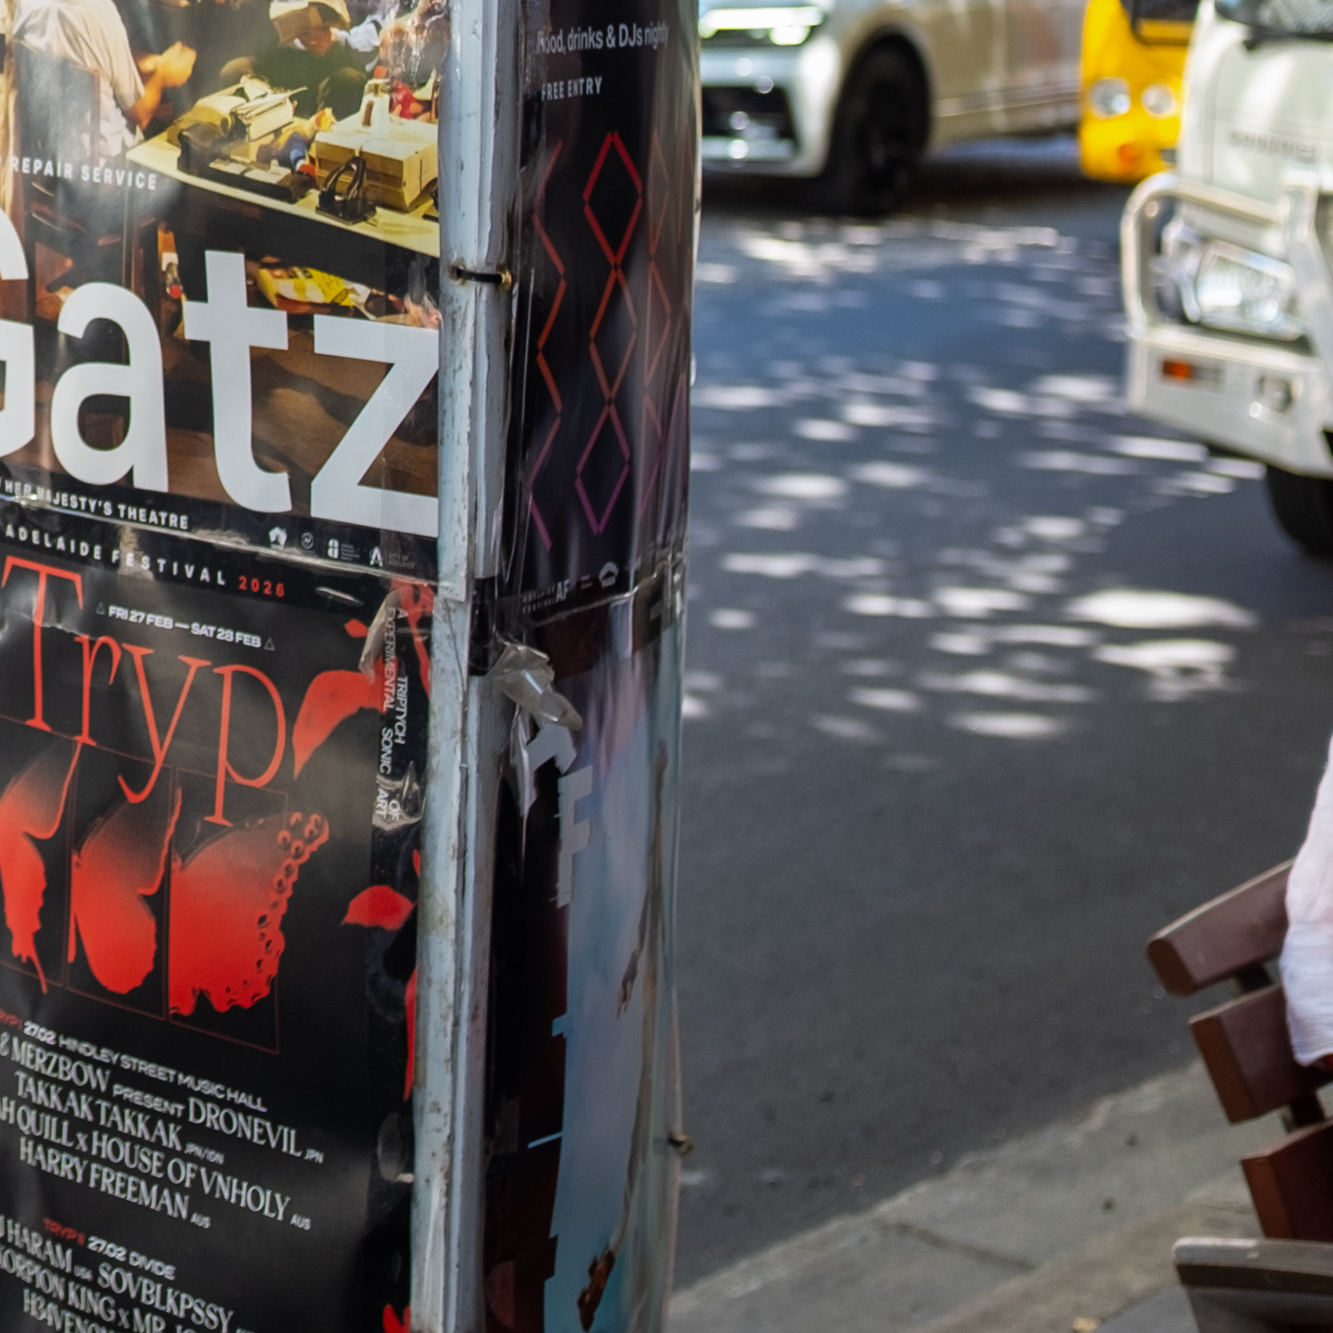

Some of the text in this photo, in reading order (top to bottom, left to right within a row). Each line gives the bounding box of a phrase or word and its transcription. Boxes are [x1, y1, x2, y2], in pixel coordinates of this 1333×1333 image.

[567, 26, 603, 51] drinks
[606, 24, 616, 49] &
[618, 23, 643, 48] DJs
[541, 76, 603, 101] FREE ENTRY
[10, 156, 73, 179] REPAIR
[81, 166, 157, 191] SERVICE
[4, 481, 32, 498] HER
[117, 504, 189, 530] THEATRE
[5, 524, 286, 598] ADELAIDE FESTIVAL 2026
[108, 605, 128, 620] FRI
[128, 610, 146, 624] 27
[146, 614, 174, 629] FEB
[191, 622, 217, 638] SAT
[217, 628, 234, 642] 28
[235, 632, 262, 648] FEB
[1, 556, 286, 828] Tryp
[374, 607, 396, 820] EXPERIMENTAL SONIC ART
[394, 676, 408, 744] TRIPTYCH
[388, 799, 401, 822] OF
[11, 1036, 111, 1093] MERZBOW
[112, 1083, 185, 1117] PRESENT
[188, 1096, 303, 1157] DRONEVIL
[59, 1034, 120, 1065] HINDLEY
[120, 1054, 177, 1083] STREET
[178, 1072, 226, 1099] MUSIC
[227, 1087, 268, 1113] HALL
[17, 1104, 74, 1147] QUILL
[92, 1130, 165, 1178] HOUSE
[167, 1157, 198, 1188] OF
[200, 1166, 291, 1222] VNHOLY
[290, 1213, 312, 1230] AUS
[20, 1136, 211, 1229] HARRY FREEMAN AUS
[7, 1218, 73, 1273] HARAM
[98, 1261, 234, 1333] SOVBLKPSSY
[68, 1280, 116, 1322] KING
